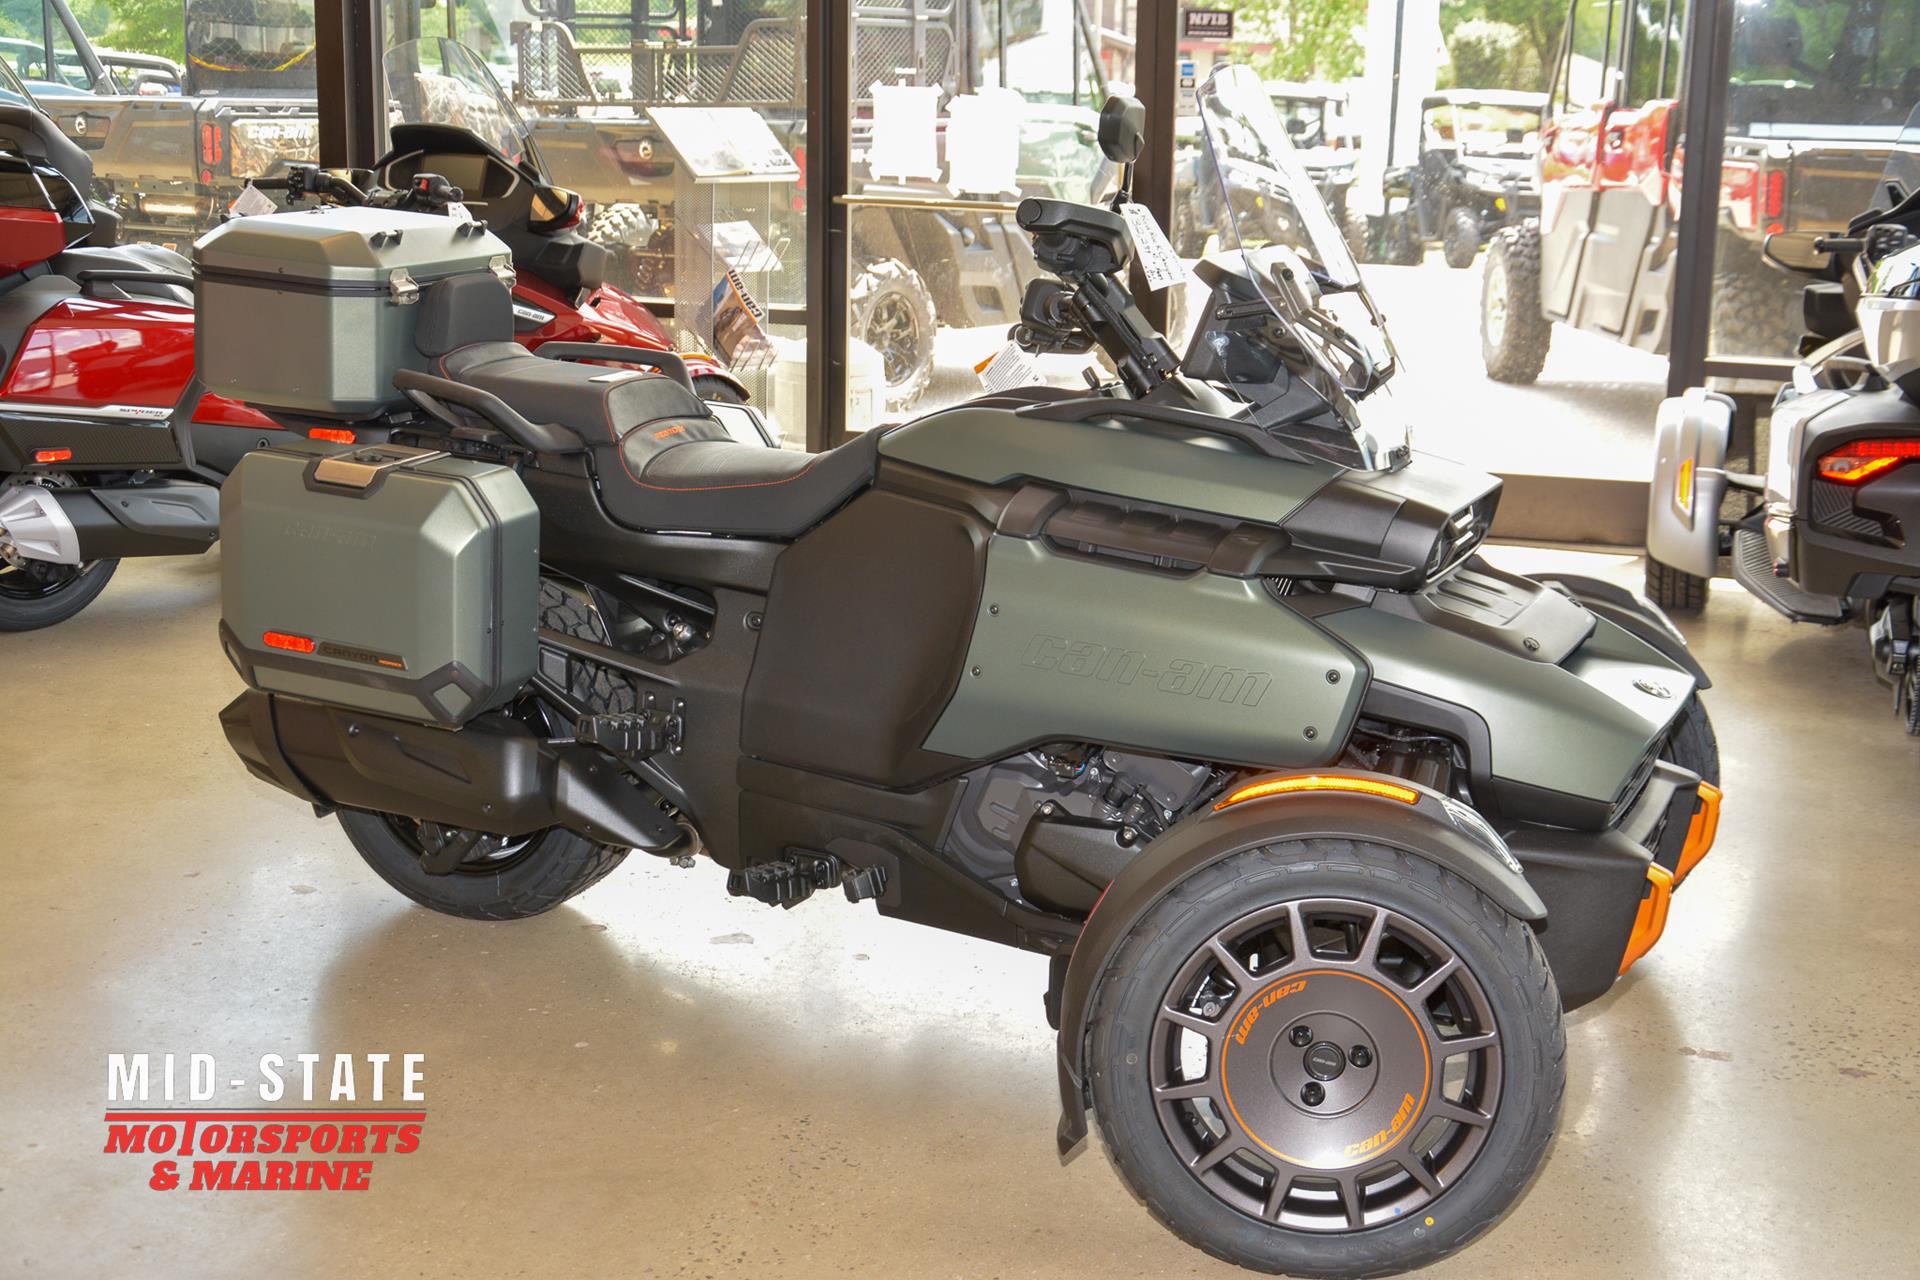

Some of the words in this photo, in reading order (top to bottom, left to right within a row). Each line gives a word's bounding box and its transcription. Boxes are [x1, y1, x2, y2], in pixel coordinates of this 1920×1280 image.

[1189, 12, 1229, 26] NFIB
[729, 269, 763, 318] can-am
[1020, 633, 1273, 707] can-am
[1235, 979, 1309, 1046] can-am
[1344, 1092, 1416, 1158] can-am
